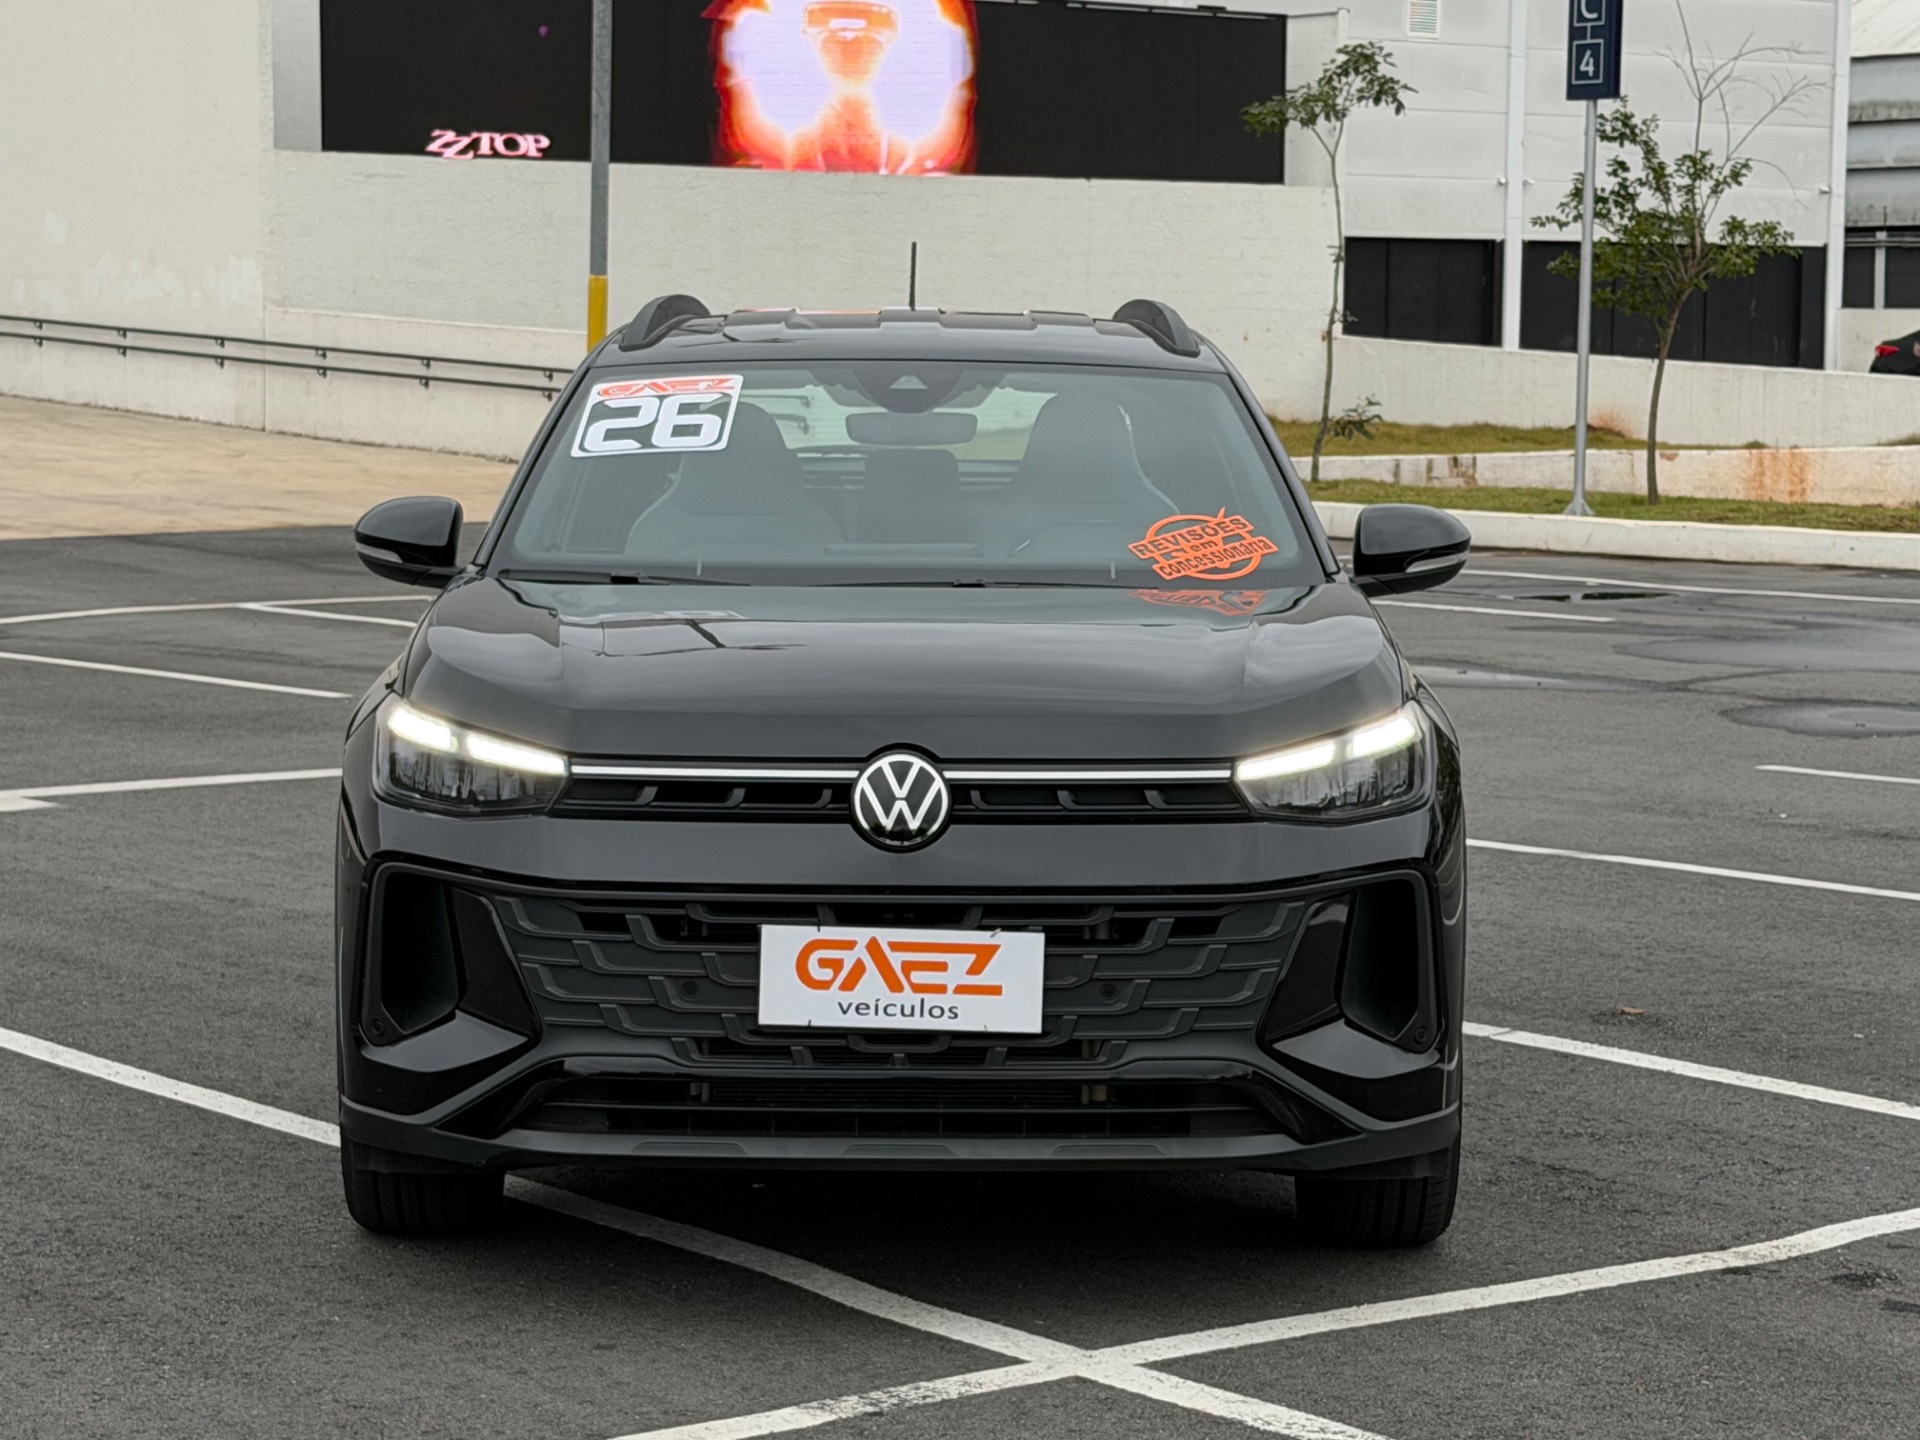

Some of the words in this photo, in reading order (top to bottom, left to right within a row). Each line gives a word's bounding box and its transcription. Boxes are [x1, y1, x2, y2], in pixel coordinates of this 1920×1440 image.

[1579, 49, 1595, 77] 4
[583, 393, 724, 452] 26
[1131, 517, 1249, 556] REVISÕES
[1189, 539, 1219, 553] em
[795, 936, 1003, 996] GAEZ
[837, 998, 960, 1020] veículos
